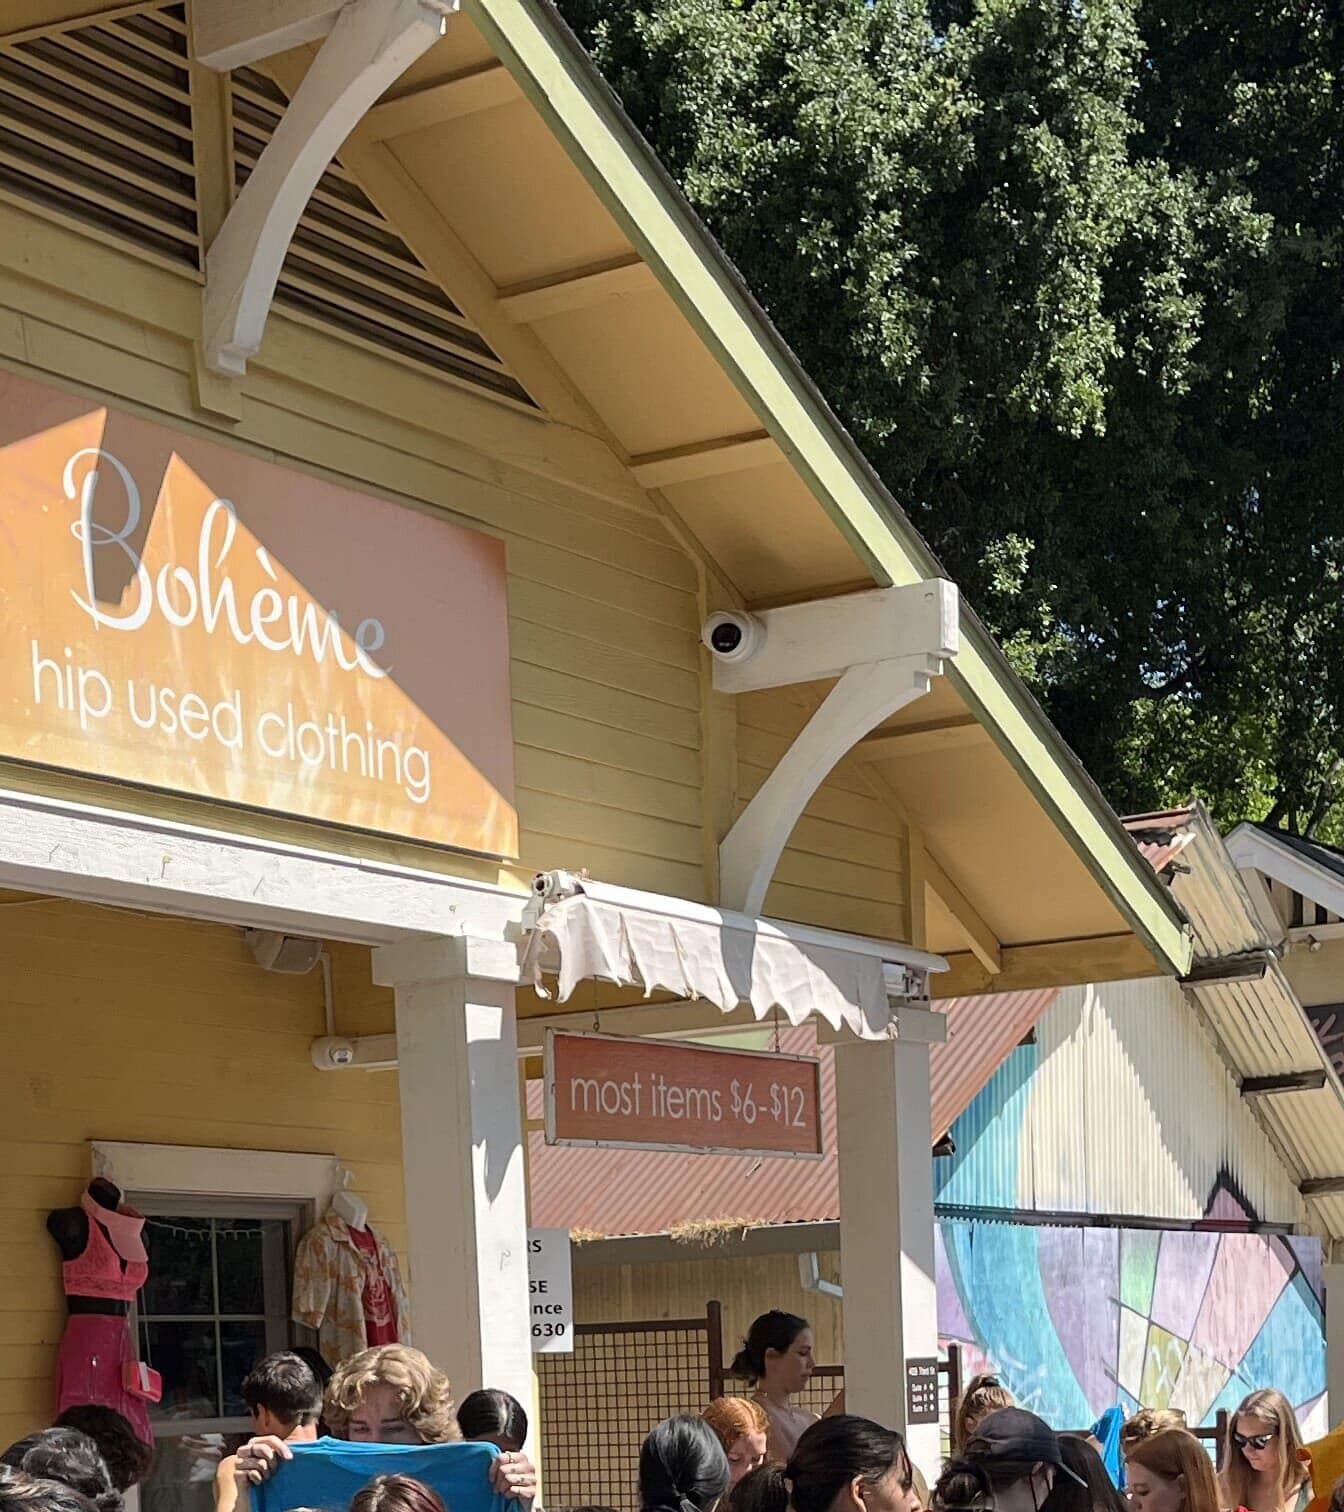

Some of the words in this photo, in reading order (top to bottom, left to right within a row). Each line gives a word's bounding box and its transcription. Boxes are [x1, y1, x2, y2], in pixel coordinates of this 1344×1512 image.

[63, 447, 392, 679] Bohème
[31, 640, 112, 729] hip
[128, 680, 243, 749] used
[258, 703, 431, 802] clothing
[570, 1072, 641, 1116] most
[651, 1075, 722, 1122] items
[730, 1078, 806, 1128] $6-$12
